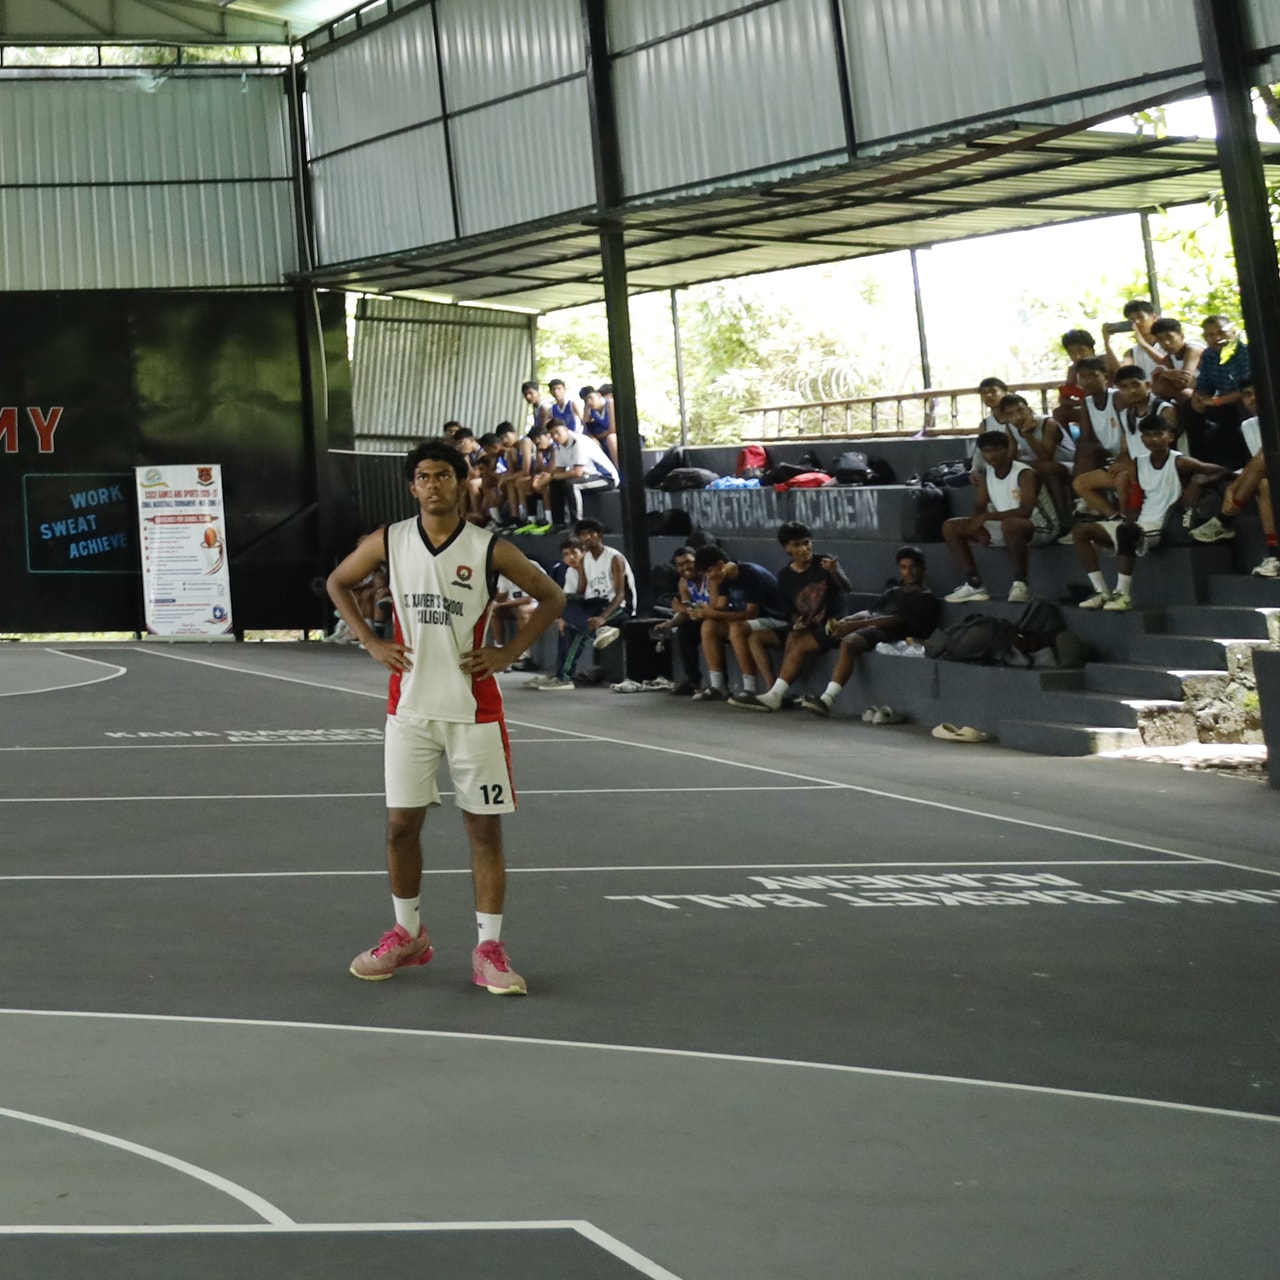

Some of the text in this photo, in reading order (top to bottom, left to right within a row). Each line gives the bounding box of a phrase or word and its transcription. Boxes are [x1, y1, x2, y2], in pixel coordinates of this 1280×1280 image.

[70, 485, 123, 509] WORK
[794, 487, 879, 528] ACADEMY
[40, 514, 97, 539] SWEAT
[69, 533, 128, 559] ACHIEVE
[479, 784, 504, 805] 12
[746, 872, 1082, 890] ACADEMY
[603, 893, 826, 910] BALL
[828, 890, 1125, 907] BASKET
